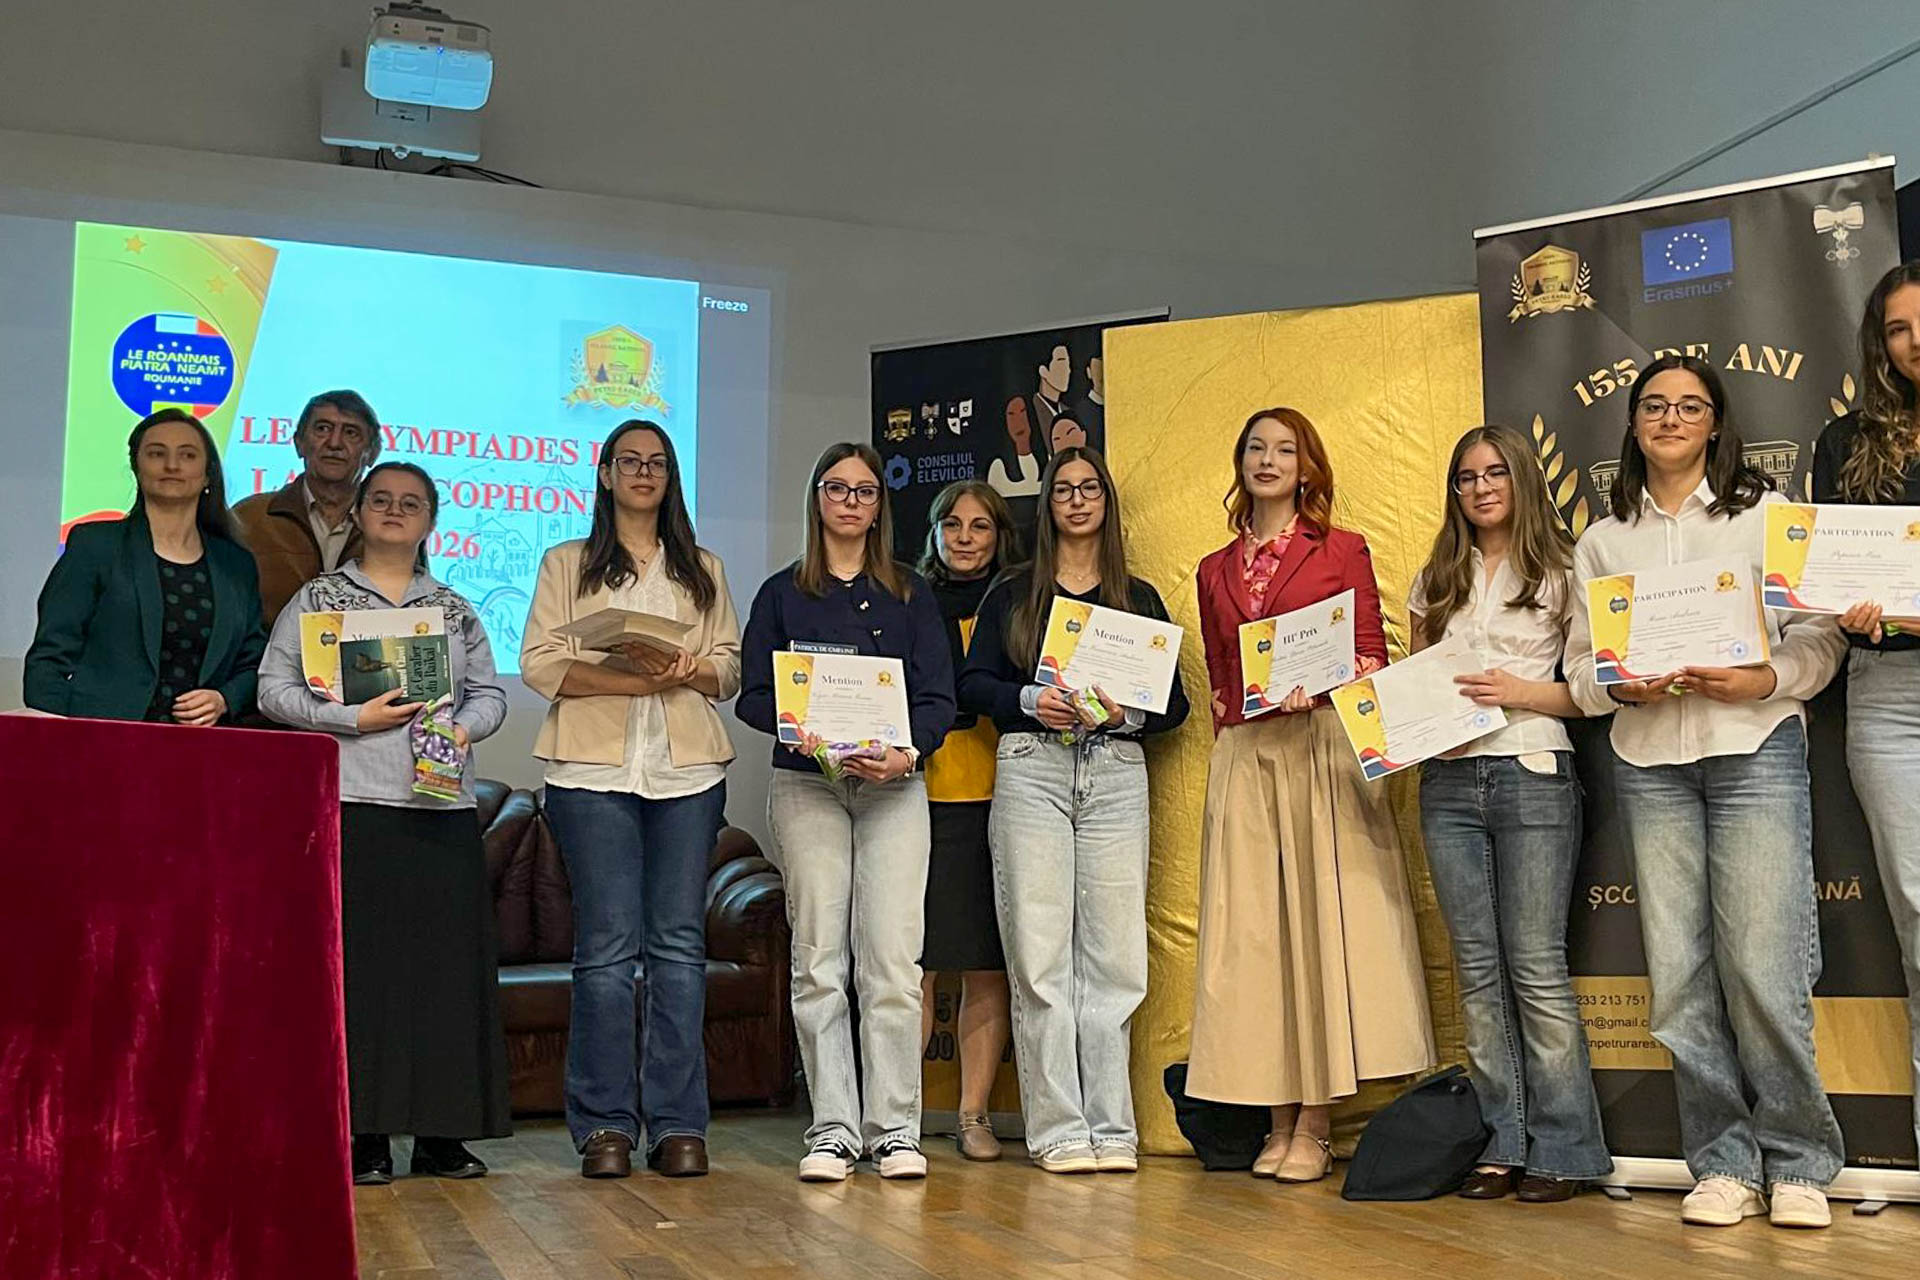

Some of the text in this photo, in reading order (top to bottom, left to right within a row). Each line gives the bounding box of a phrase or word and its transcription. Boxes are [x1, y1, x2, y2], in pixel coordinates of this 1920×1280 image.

[1643, 277, 1734, 303] Erasmus+
[703, 296, 749, 312] Freeze
[128, 349, 220, 366] LE ROANNAIS
[120, 359, 227, 376] PIATRA NEAMT
[1572, 357, 1640, 407] 155
[1725, 343, 1804, 381] ANI
[143, 373, 202, 385] ROUMANIE
[239, 416, 293, 444] LE
[381, 423, 580, 466] YMPIADES
[917, 452, 975, 469] CONSILIUL
[917, 466, 975, 483] ELEVILOR
[1814, 528, 1894, 537] PARTICIPATION
[426, 530, 481, 560] 026
[1634, 585, 1707, 603] PARTICIPATION
[1094, 628, 1134, 646] Mention
[822, 675, 862, 686] Mention
[1576, 994, 1646, 1006] 233 213 751
